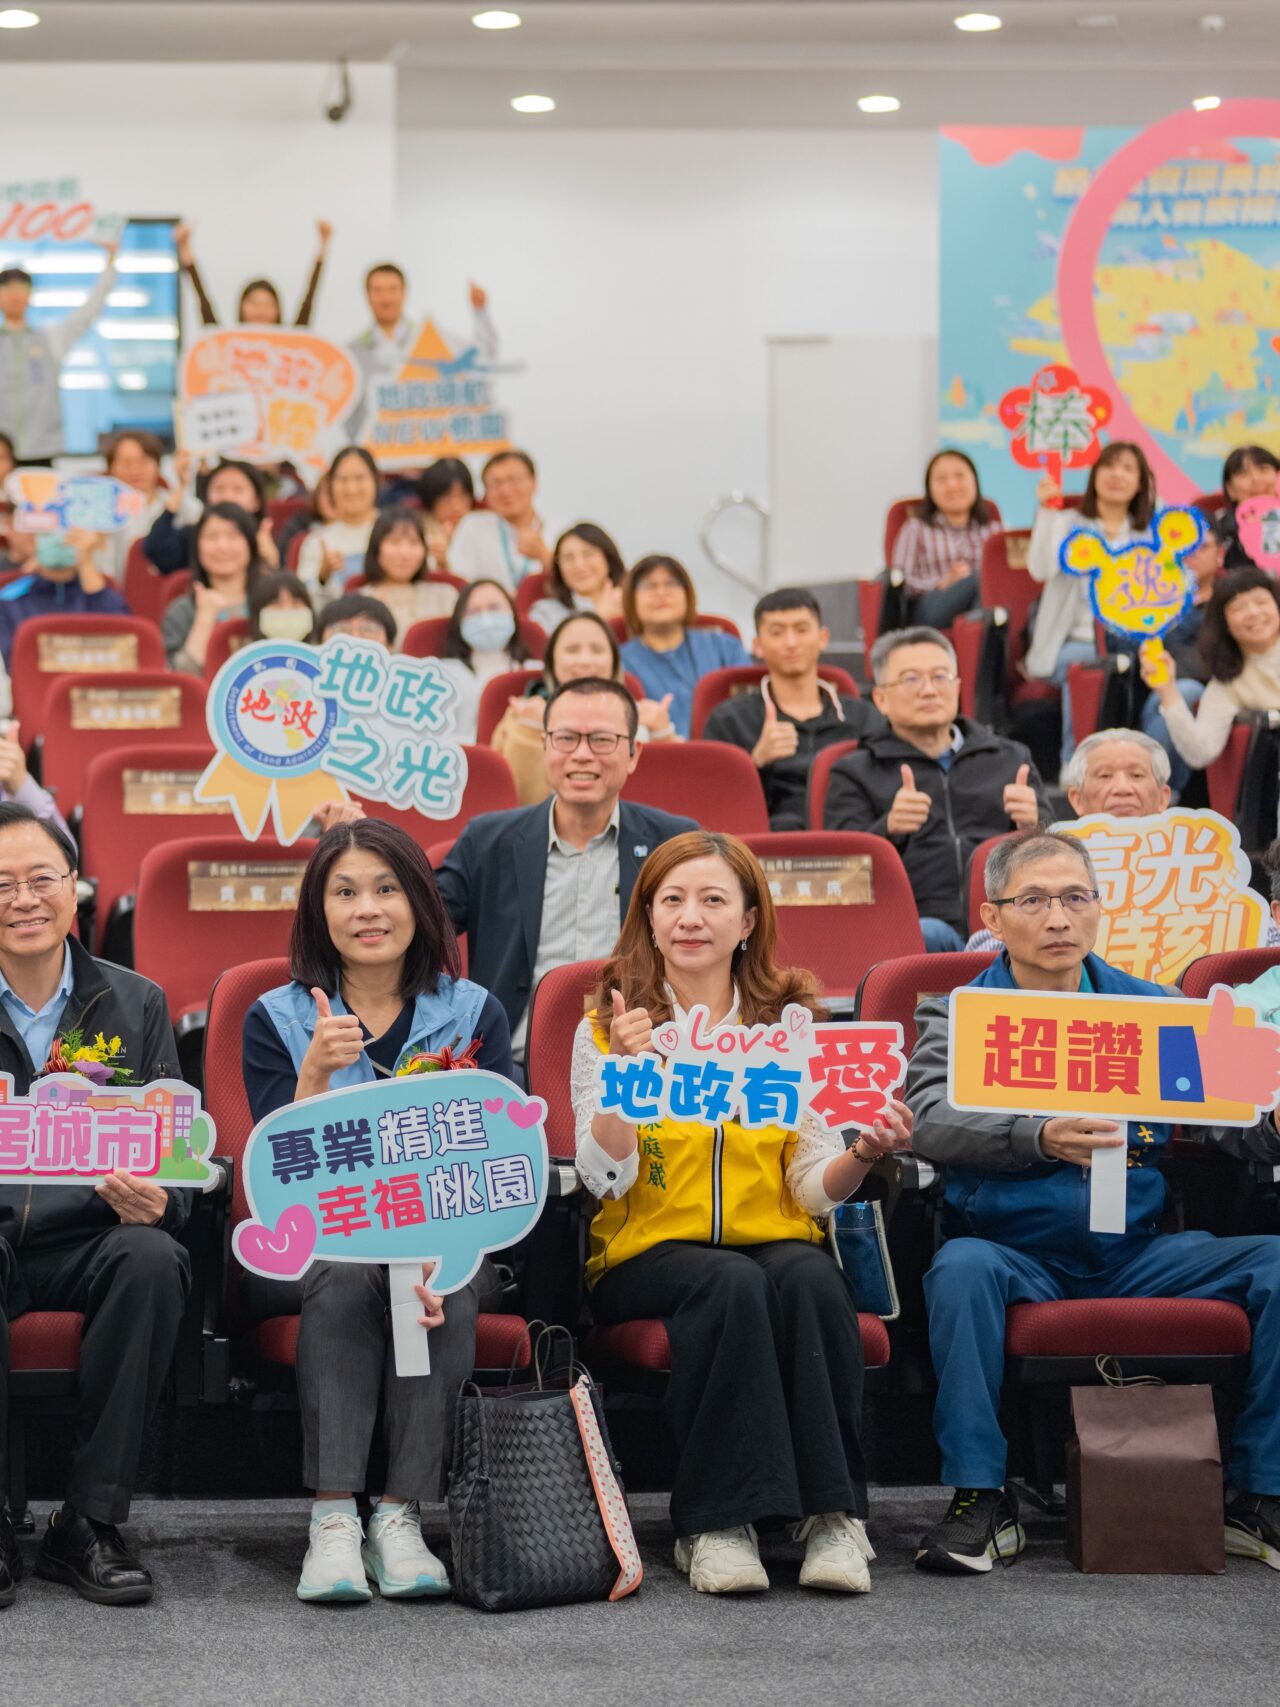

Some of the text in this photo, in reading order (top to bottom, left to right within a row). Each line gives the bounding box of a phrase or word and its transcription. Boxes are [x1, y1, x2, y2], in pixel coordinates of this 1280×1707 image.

[240, 688, 318, 739] 地政
[320, 649, 447, 725] 地政
[326, 724, 451, 803] 之光
[690, 1010, 791, 1054] Love
[983, 1015, 1143, 1095] 超讚
[600, 1027, 902, 1129] 地政有愛
[267, 1098, 489, 1185] 專業精進
[317, 1153, 537, 1238] 幸福桃園
